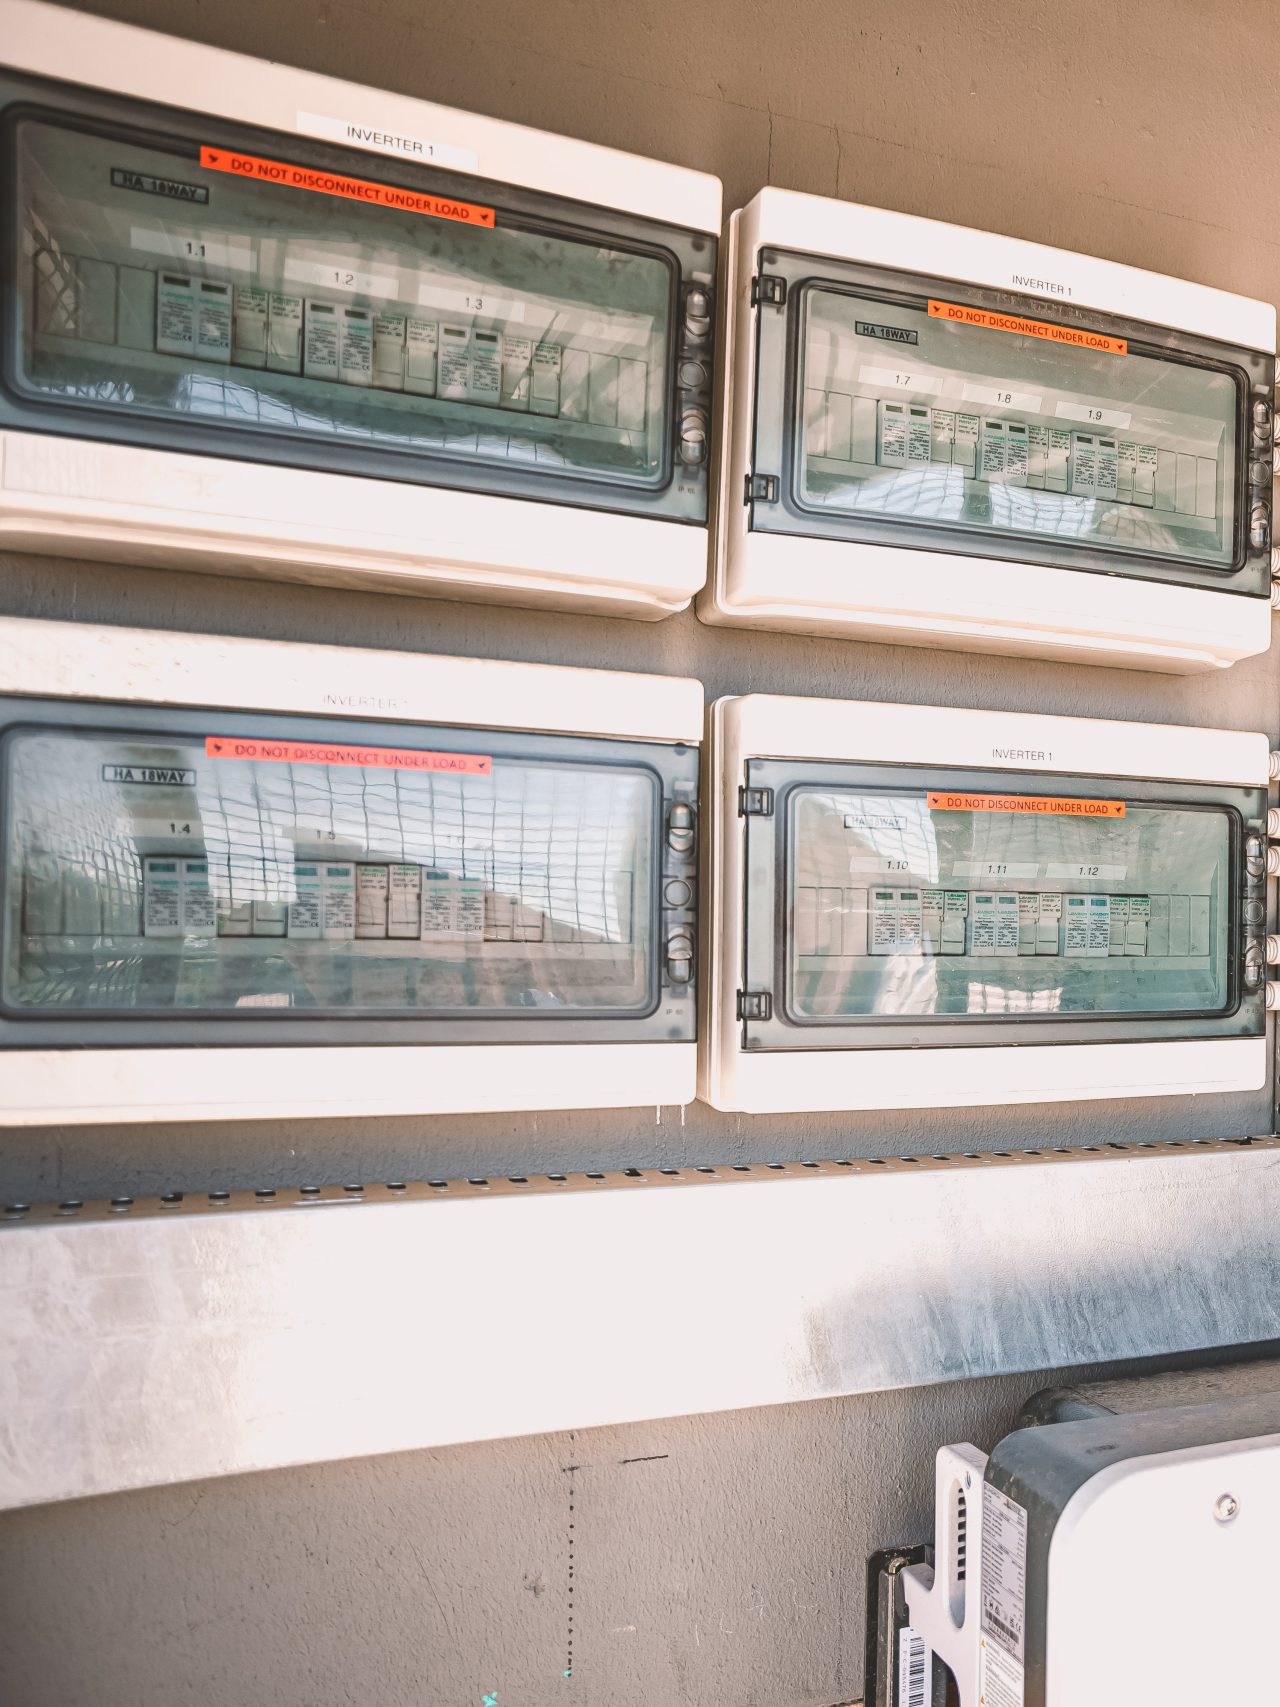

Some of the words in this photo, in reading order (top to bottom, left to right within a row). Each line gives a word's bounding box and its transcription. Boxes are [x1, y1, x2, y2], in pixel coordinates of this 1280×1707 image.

[347, 126, 423, 153] INVERTER
[428, 145, 434, 155] 1
[122, 173, 144, 189] HA
[231, 158, 253, 172] DO
[258, 165, 289, 180] NOT
[292, 172, 382, 200] DISCONNECT
[385, 191, 431, 211] UNDER
[435, 202, 470, 219] LOAD
[186, 242, 206, 257] 1.1
[334, 271, 354, 286] 1.2
[1012, 274, 1064, 295] INVERTER
[1067, 286, 1072, 297] 1
[465, 296, 483, 310] 1.3
[862, 325, 877, 336] HA
[880, 327, 911, 342] 18WAY
[947, 307, 963, 319] DO
[966, 310, 986, 324] NOT
[989, 315, 1049, 336] DISCONNECT
[1051, 327, 1083, 343] UNDER
[1086, 335, 1110, 349] LOAD
[895, 374, 911, 386] 1.7
[996, 392, 1012, 404] 1.8
[1087, 409, 1102, 421] 1.9
[234, 745, 256, 756] DO
[261, 746, 290, 758] NOT
[294, 749, 380, 763] DISCONNECT
[384, 755, 429, 767] UNDER
[433, 758, 467, 770] LOAD
[992, 748, 1046, 760] INVERTER
[1048, 752, 1053, 761] 1
[114, 768, 134, 779] HA
[141, 770, 187, 783] 18WAY
[947, 798, 962, 808] DO
[965, 799, 985, 809] NOT
[988, 800, 1048, 811] DISCONNECT
[1050, 802, 1082, 813] UNDER
[1084, 804, 1108, 814] LOAD
[170, 823, 191, 834] 1.4
[887, 860, 909, 870] 1.10
[987, 865, 1008, 875] 1.11
[1079, 866, 1099, 876] 1.12
